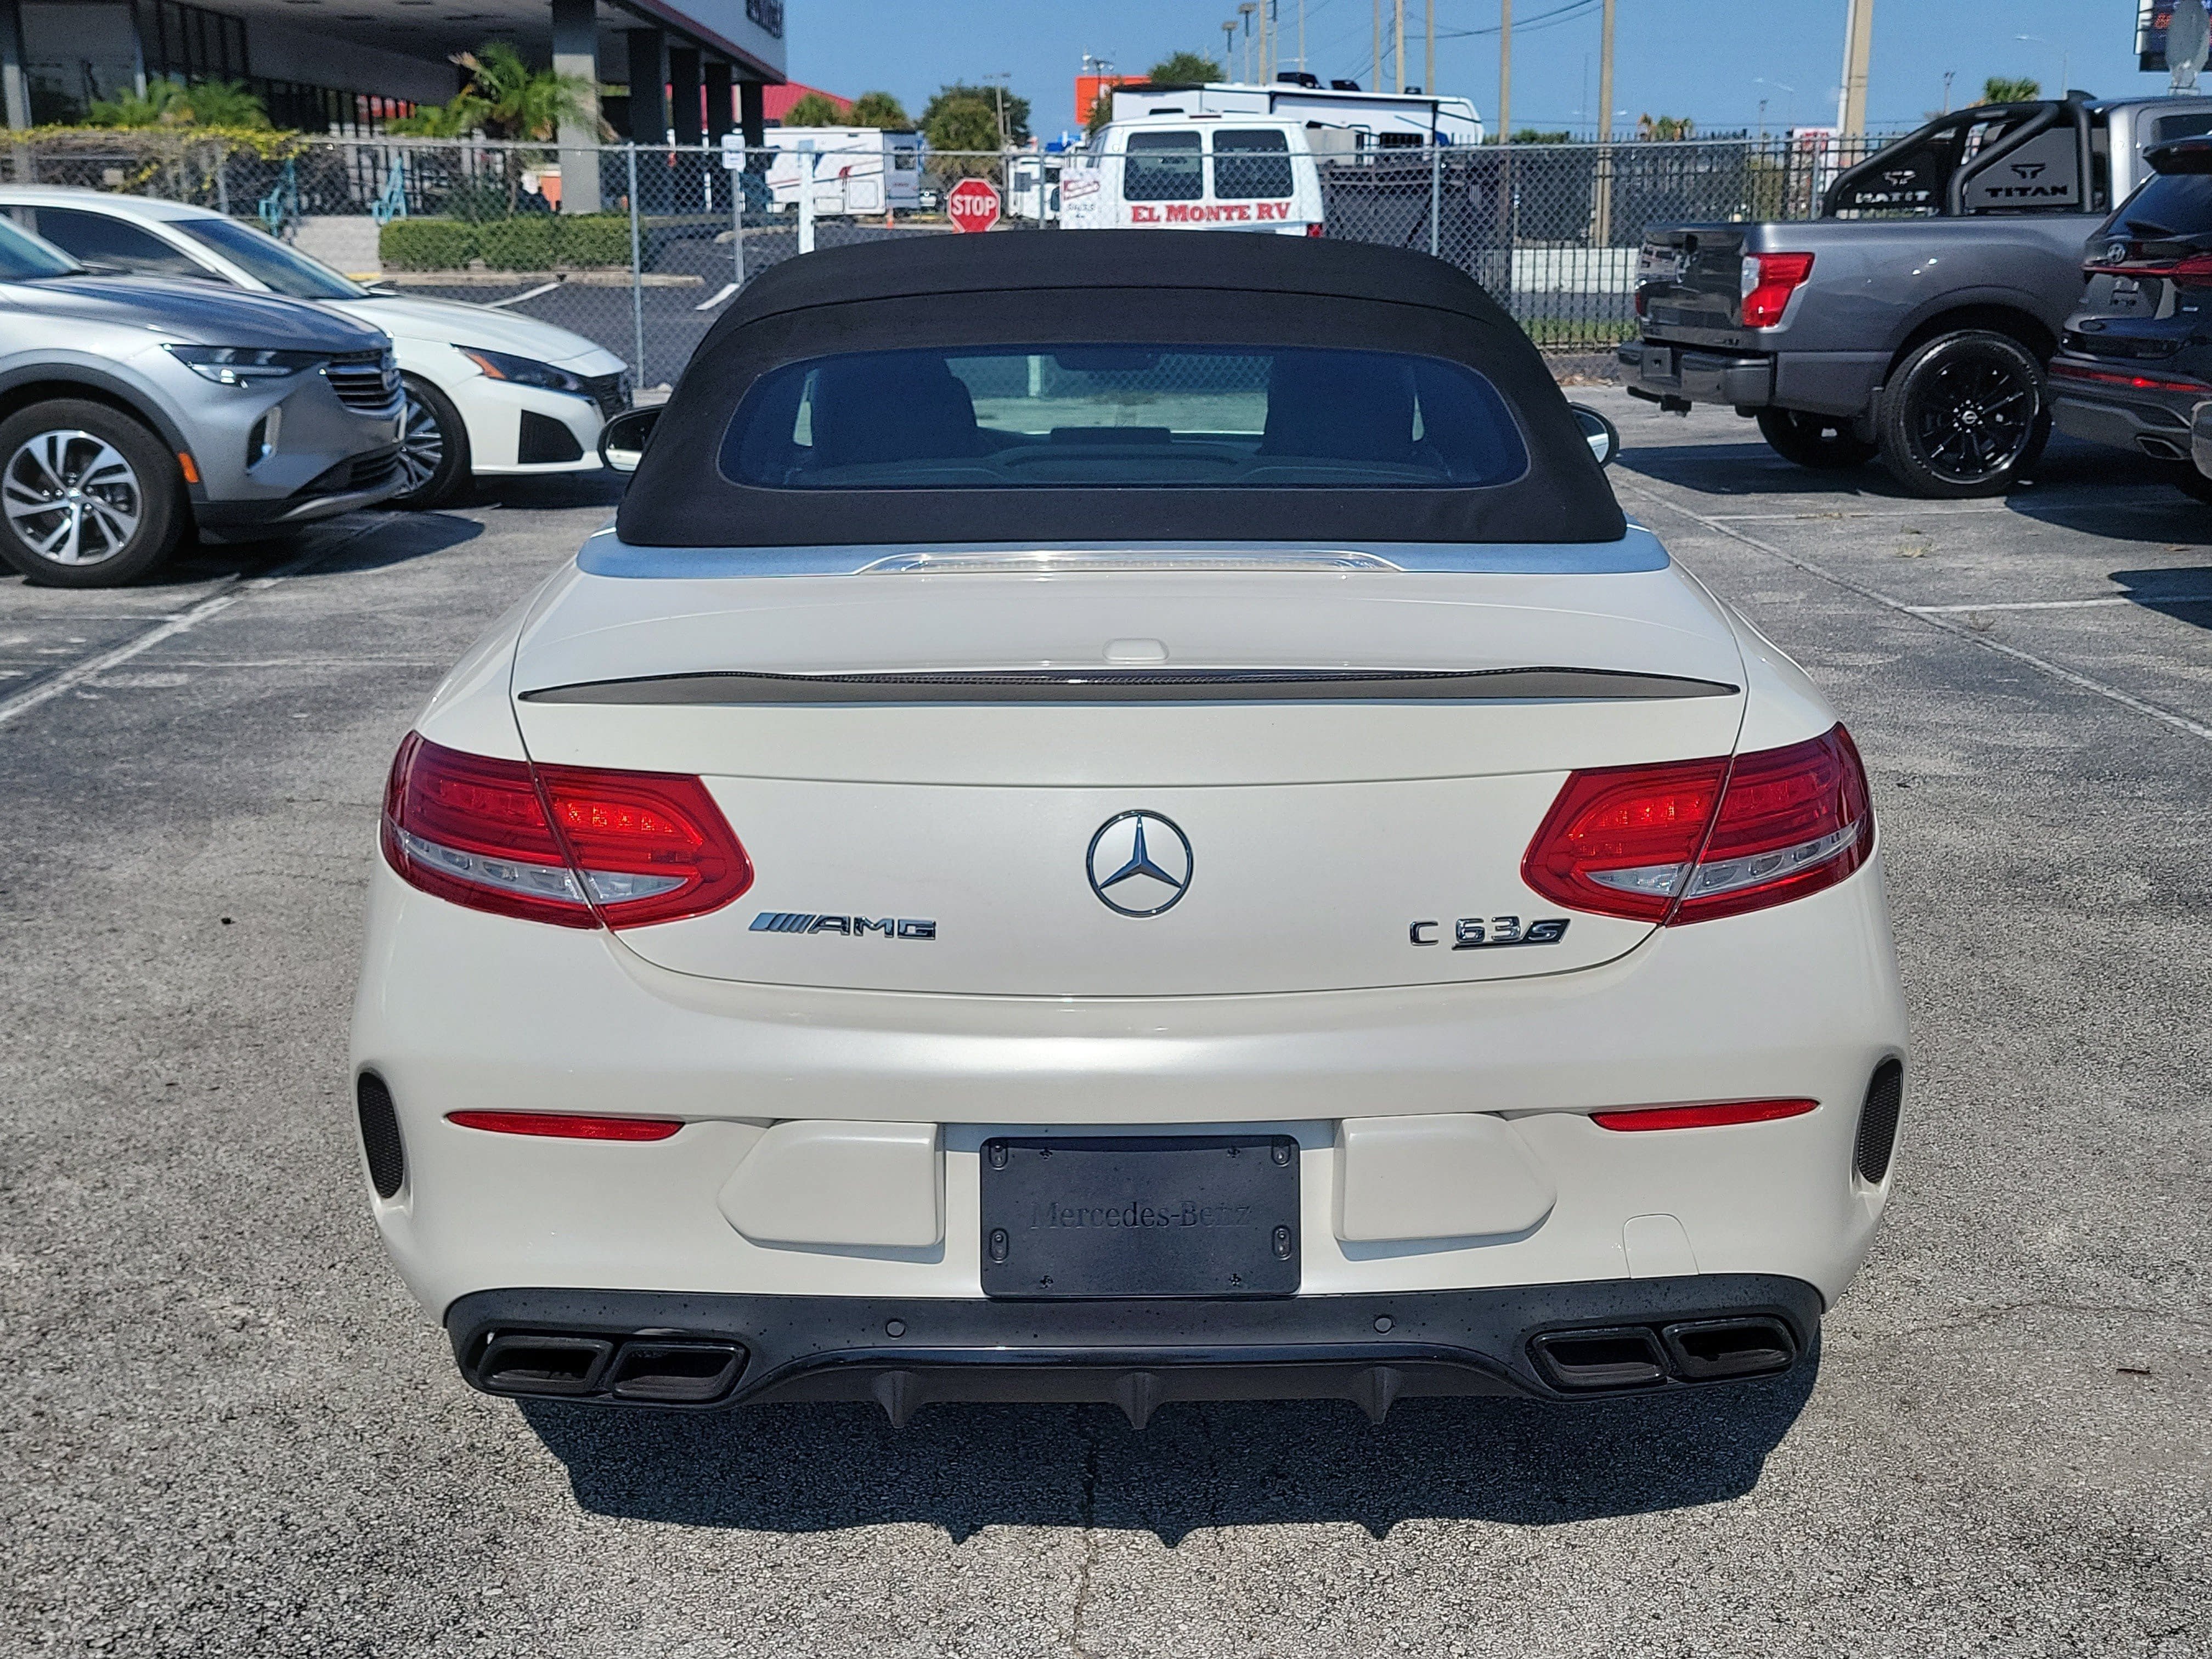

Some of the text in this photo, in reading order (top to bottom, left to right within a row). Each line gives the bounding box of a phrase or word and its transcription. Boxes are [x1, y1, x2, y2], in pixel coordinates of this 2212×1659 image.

[1985, 186, 2068, 197] TITAN
[951, 195, 996, 217] STOP
[1131, 202, 1290, 222] EL MONTE RV
[1409, 921, 1438, 946] C
[1030, 1201, 1251, 1229] Mercedes-Benz
